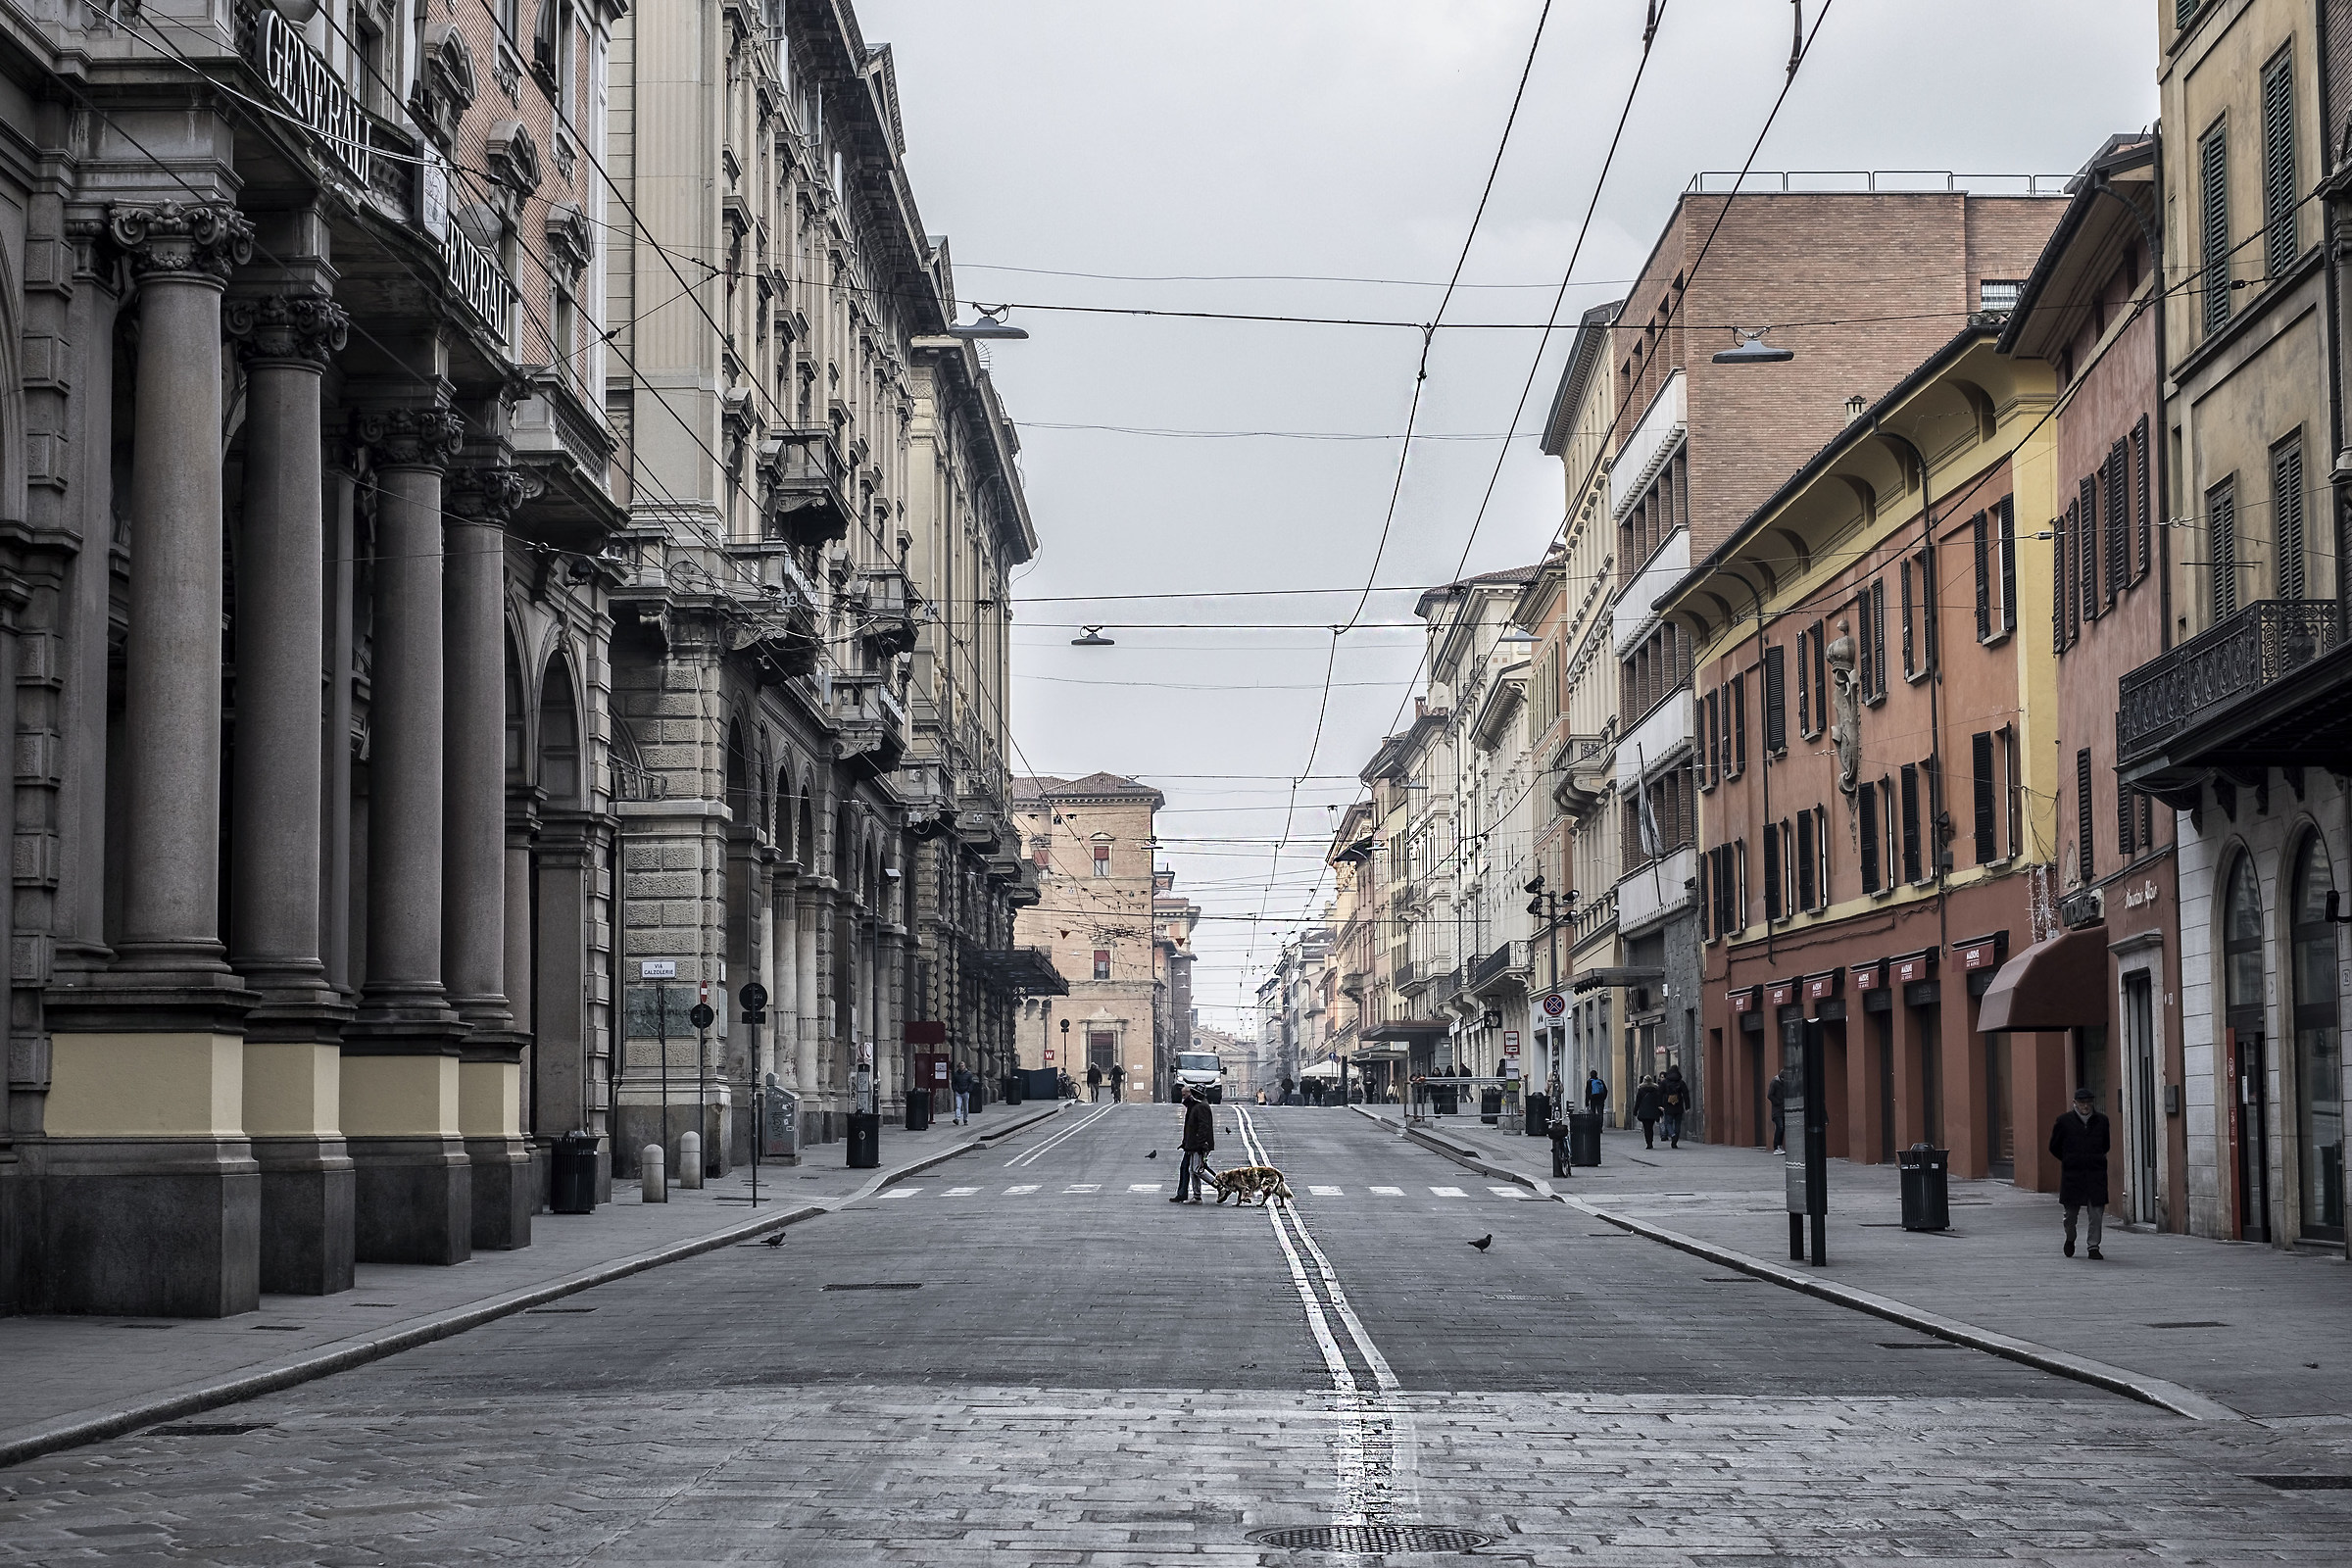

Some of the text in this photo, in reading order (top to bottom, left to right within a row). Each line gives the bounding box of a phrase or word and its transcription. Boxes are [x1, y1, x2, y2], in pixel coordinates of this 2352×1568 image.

[266, 10, 372, 187] GENERALI
[782, 596, 797, 606] 13
[923, 607, 939, 616] 14
[1045, 1051, 1054, 1059] W
